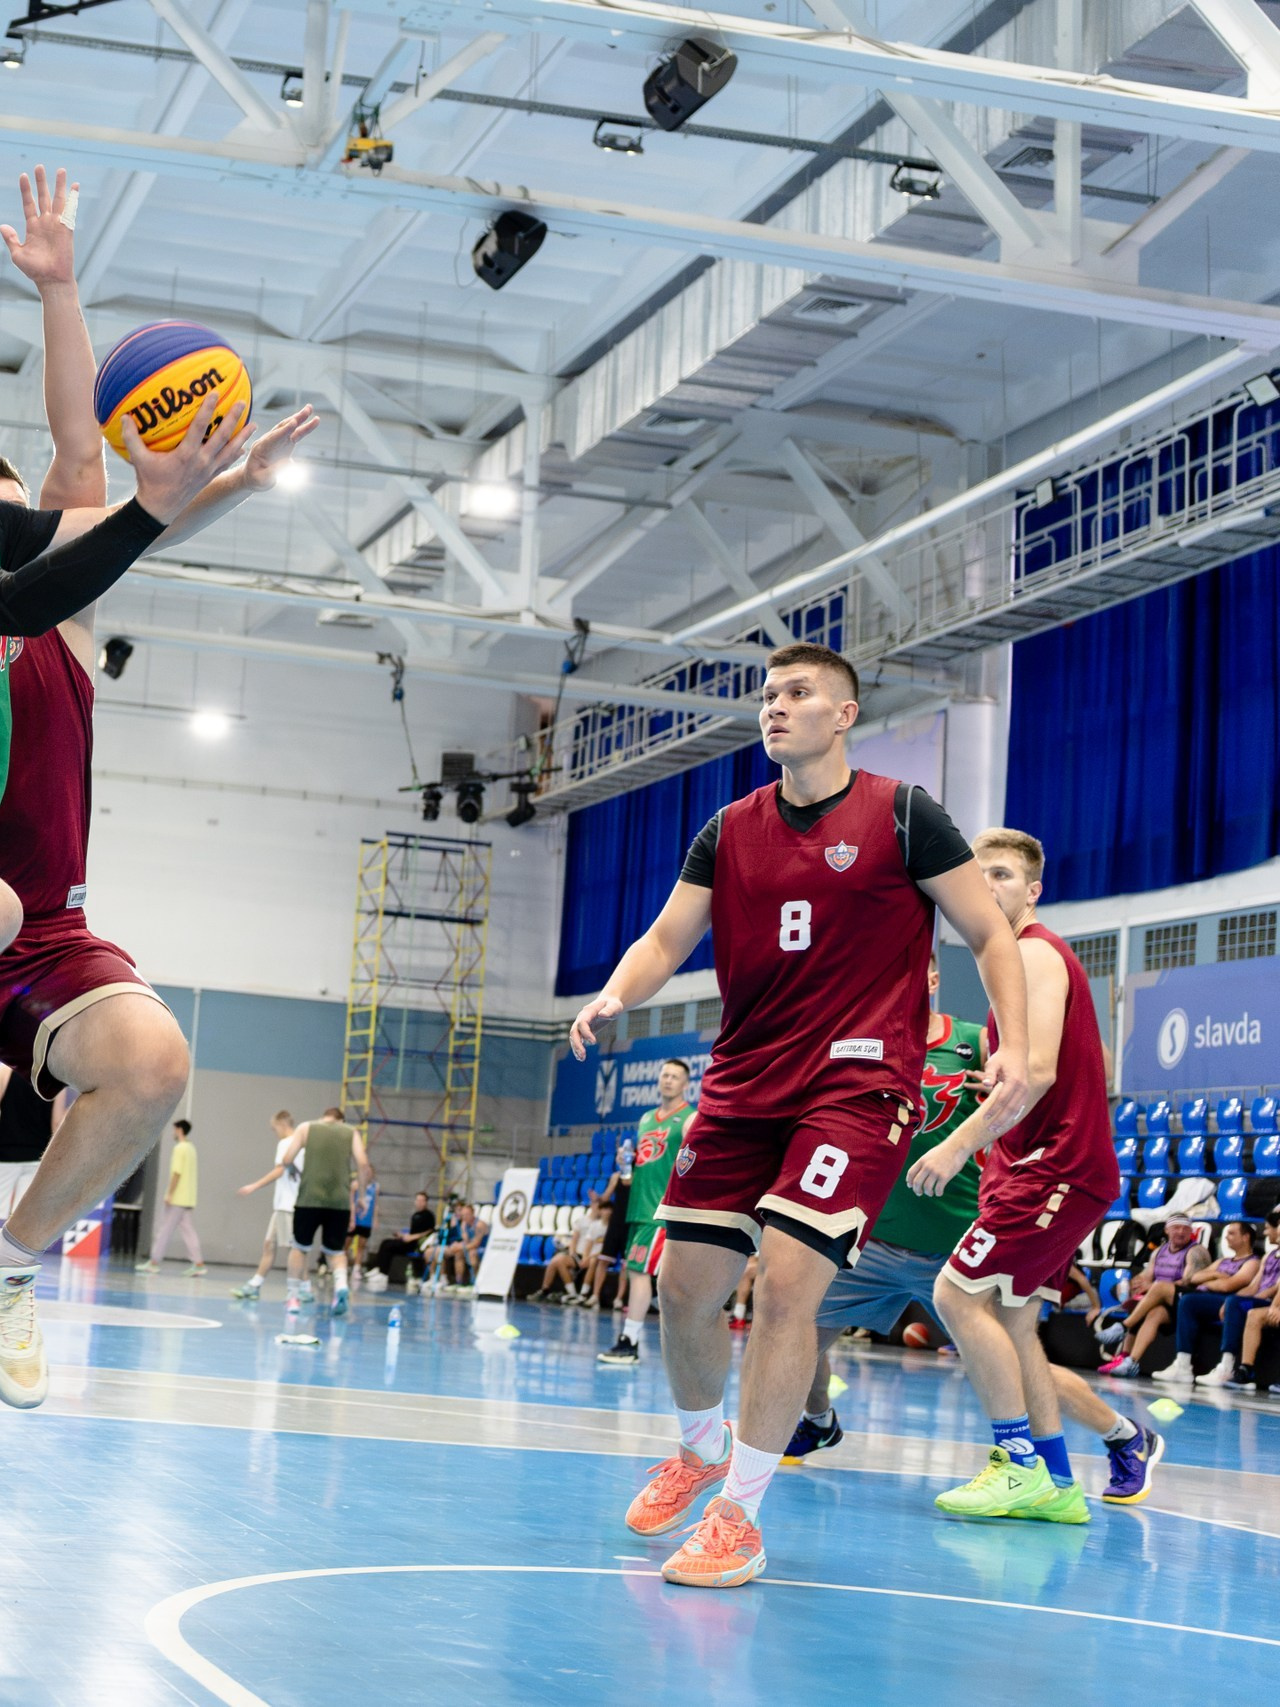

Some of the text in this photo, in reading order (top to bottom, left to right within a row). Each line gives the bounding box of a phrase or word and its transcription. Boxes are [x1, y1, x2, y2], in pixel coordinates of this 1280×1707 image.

[123, 367, 225, 434] Wilson
[779, 900, 812, 951] 8
[1193, 1011, 1261, 1049] slavda
[799, 1143, 849, 1199] 8
